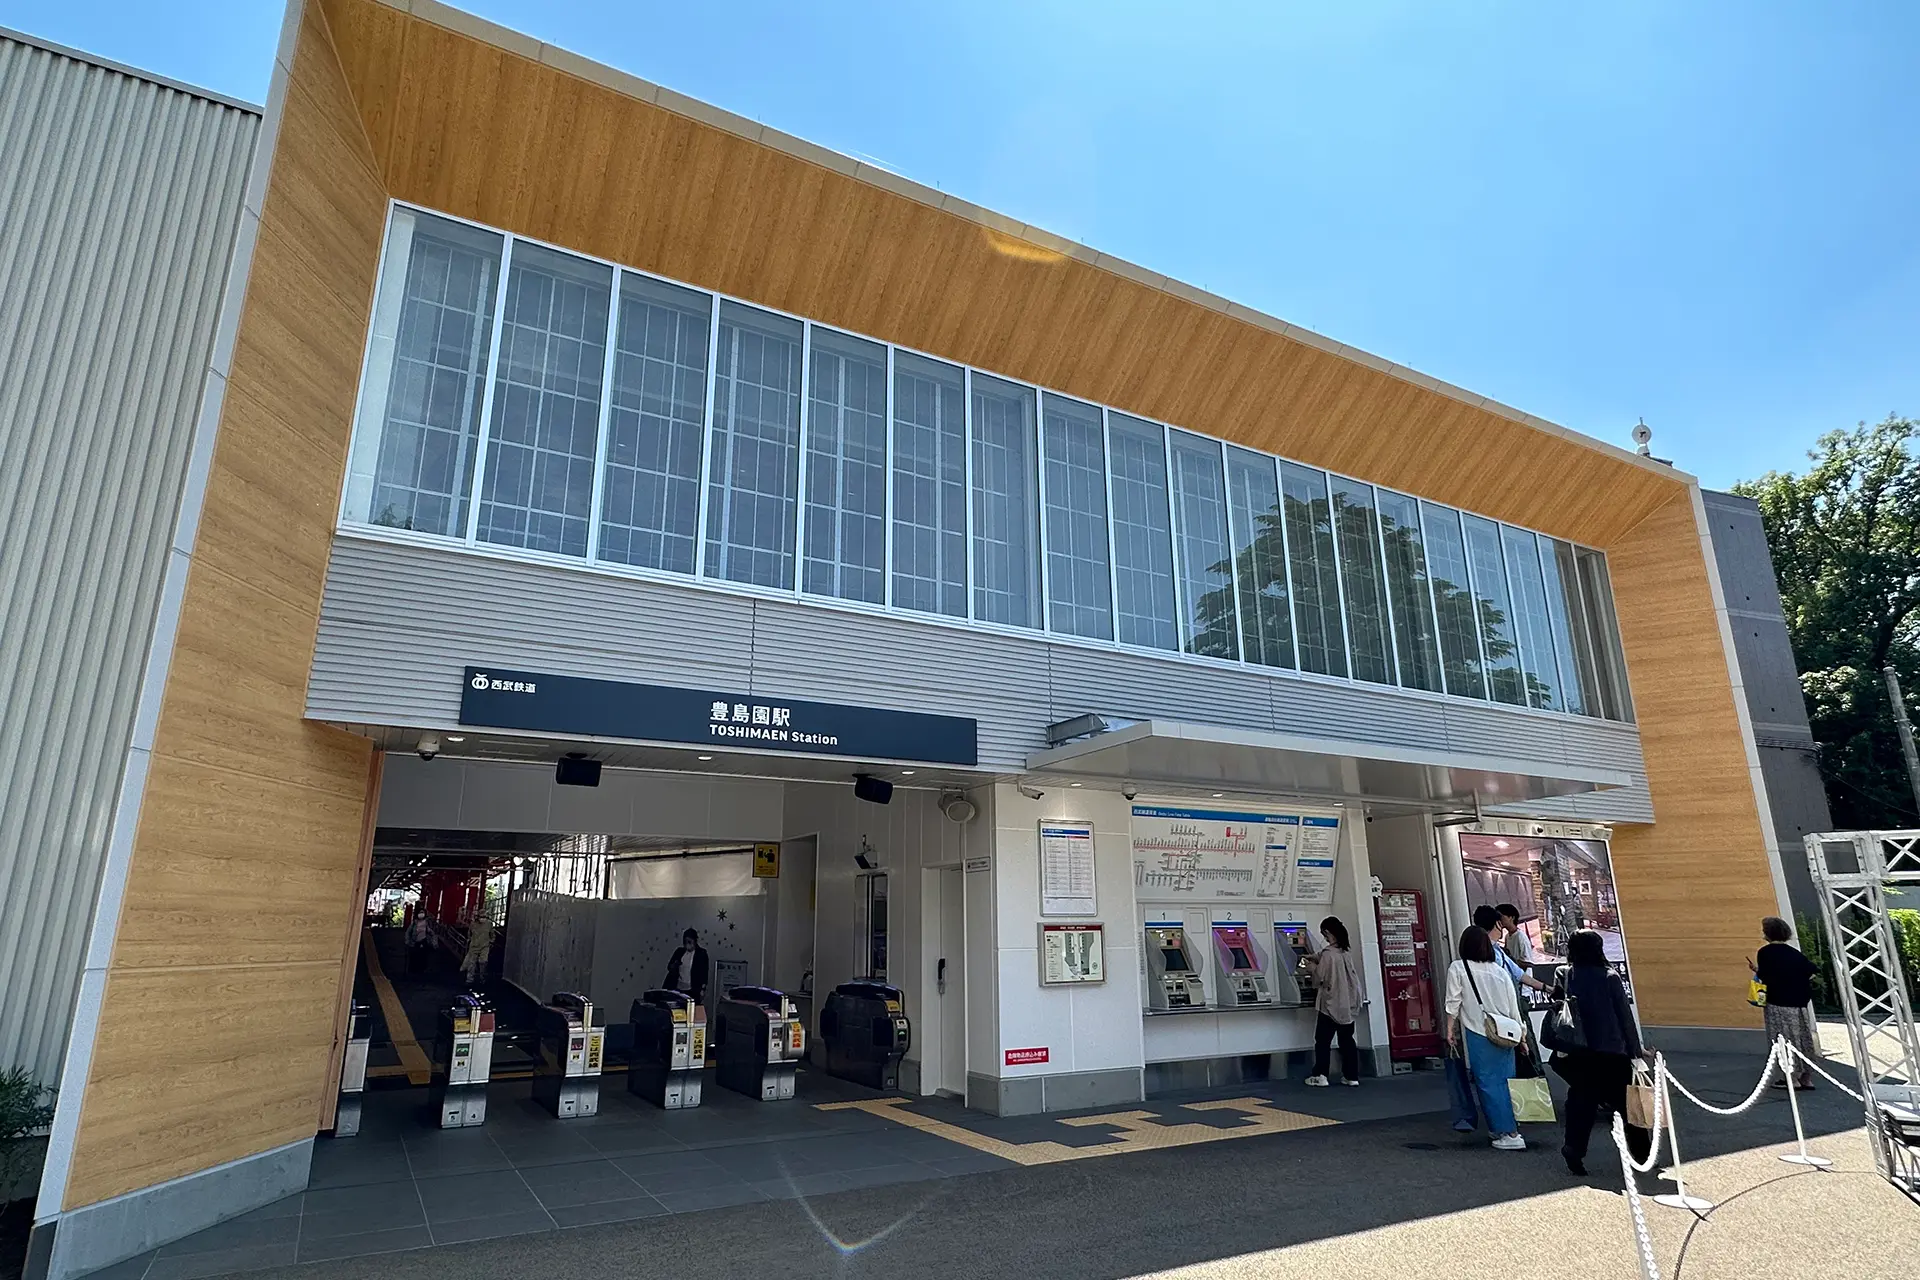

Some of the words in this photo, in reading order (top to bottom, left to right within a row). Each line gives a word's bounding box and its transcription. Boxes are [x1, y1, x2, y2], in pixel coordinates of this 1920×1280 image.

[491, 679, 536, 693] 西武鉄道
[710, 701, 790, 727] 豊島園駅
[709, 724, 788, 741] TOSHIMAEN
[791, 731, 838, 745] Station
[1161, 912, 1166, 921] 1
[1226, 911, 1232, 921] 2
[1287, 912, 1293, 921] 3
